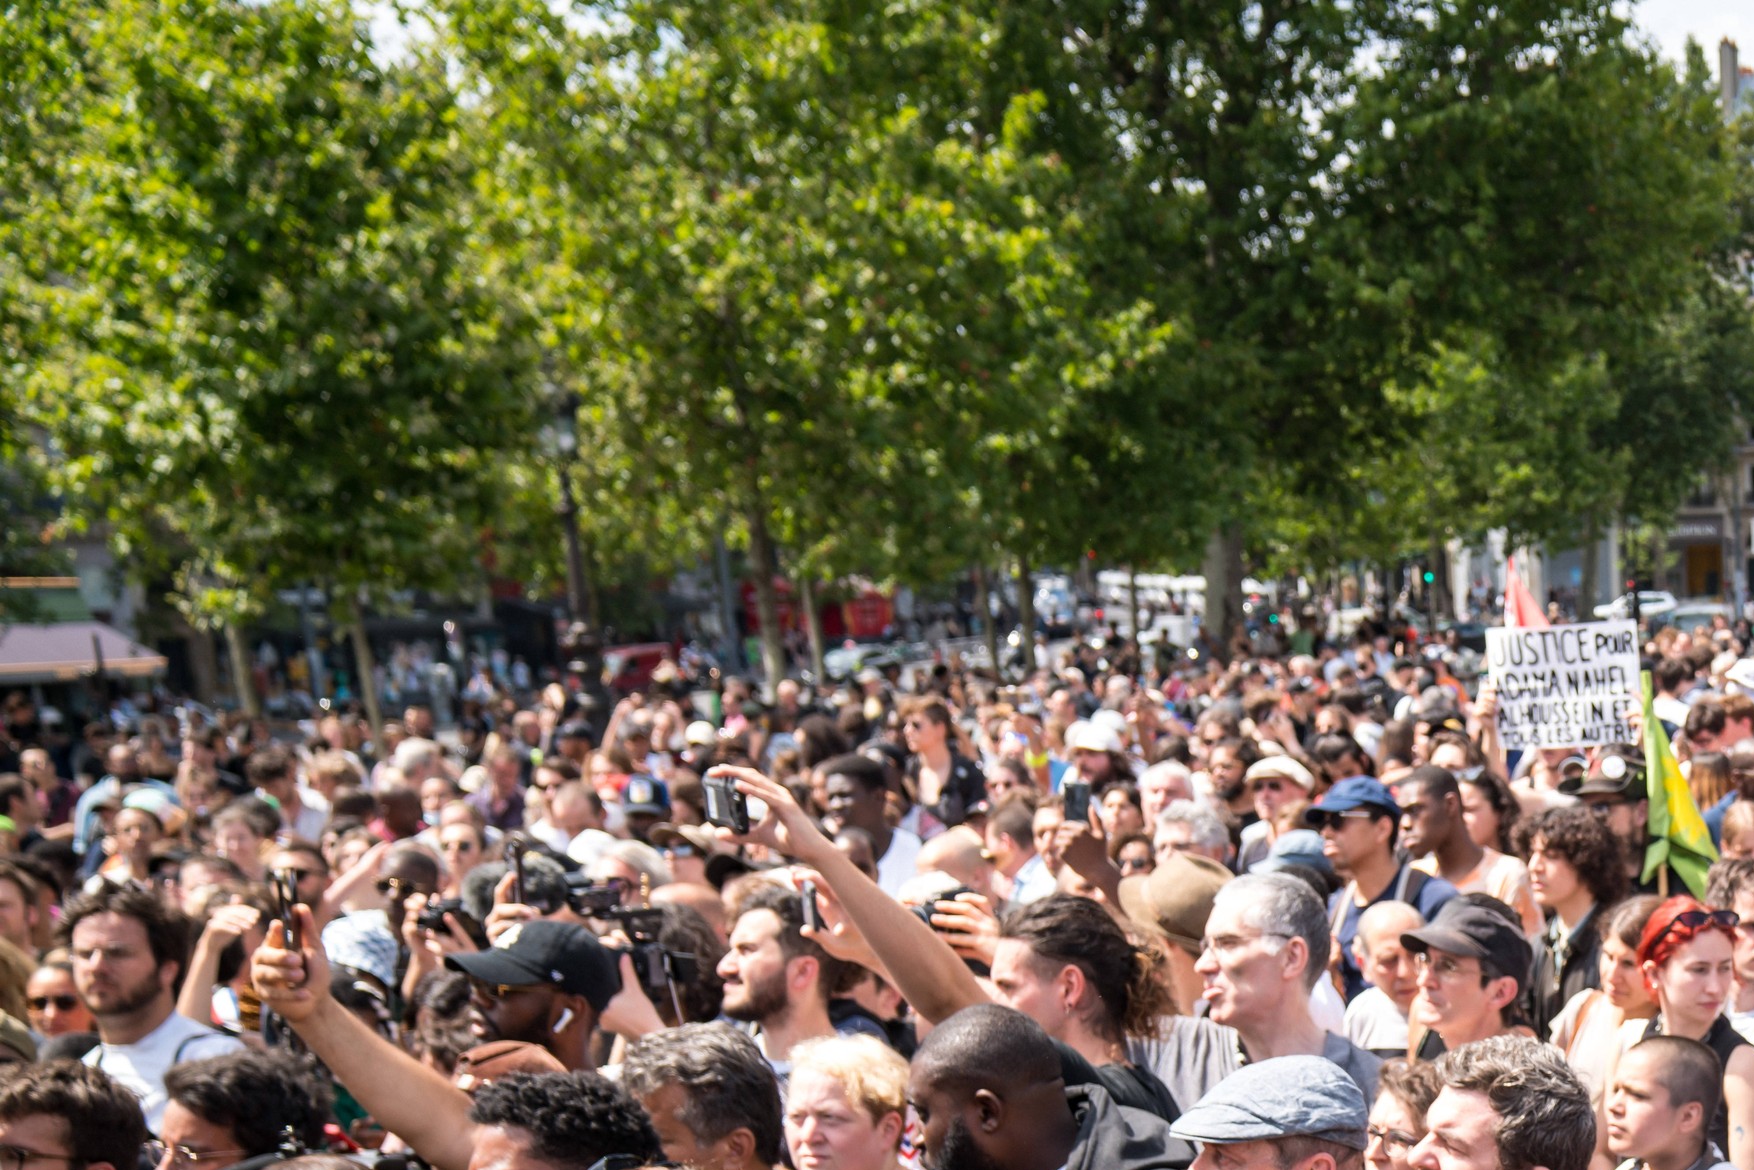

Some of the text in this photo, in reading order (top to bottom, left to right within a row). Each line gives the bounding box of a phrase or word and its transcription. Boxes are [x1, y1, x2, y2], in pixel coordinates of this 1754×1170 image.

[1494, 628, 1635, 667] JUSTICE POUR
[1496, 665, 1631, 700] ADAMA NAHEL
[1499, 700, 1605, 728] ALHOUSSEIN
